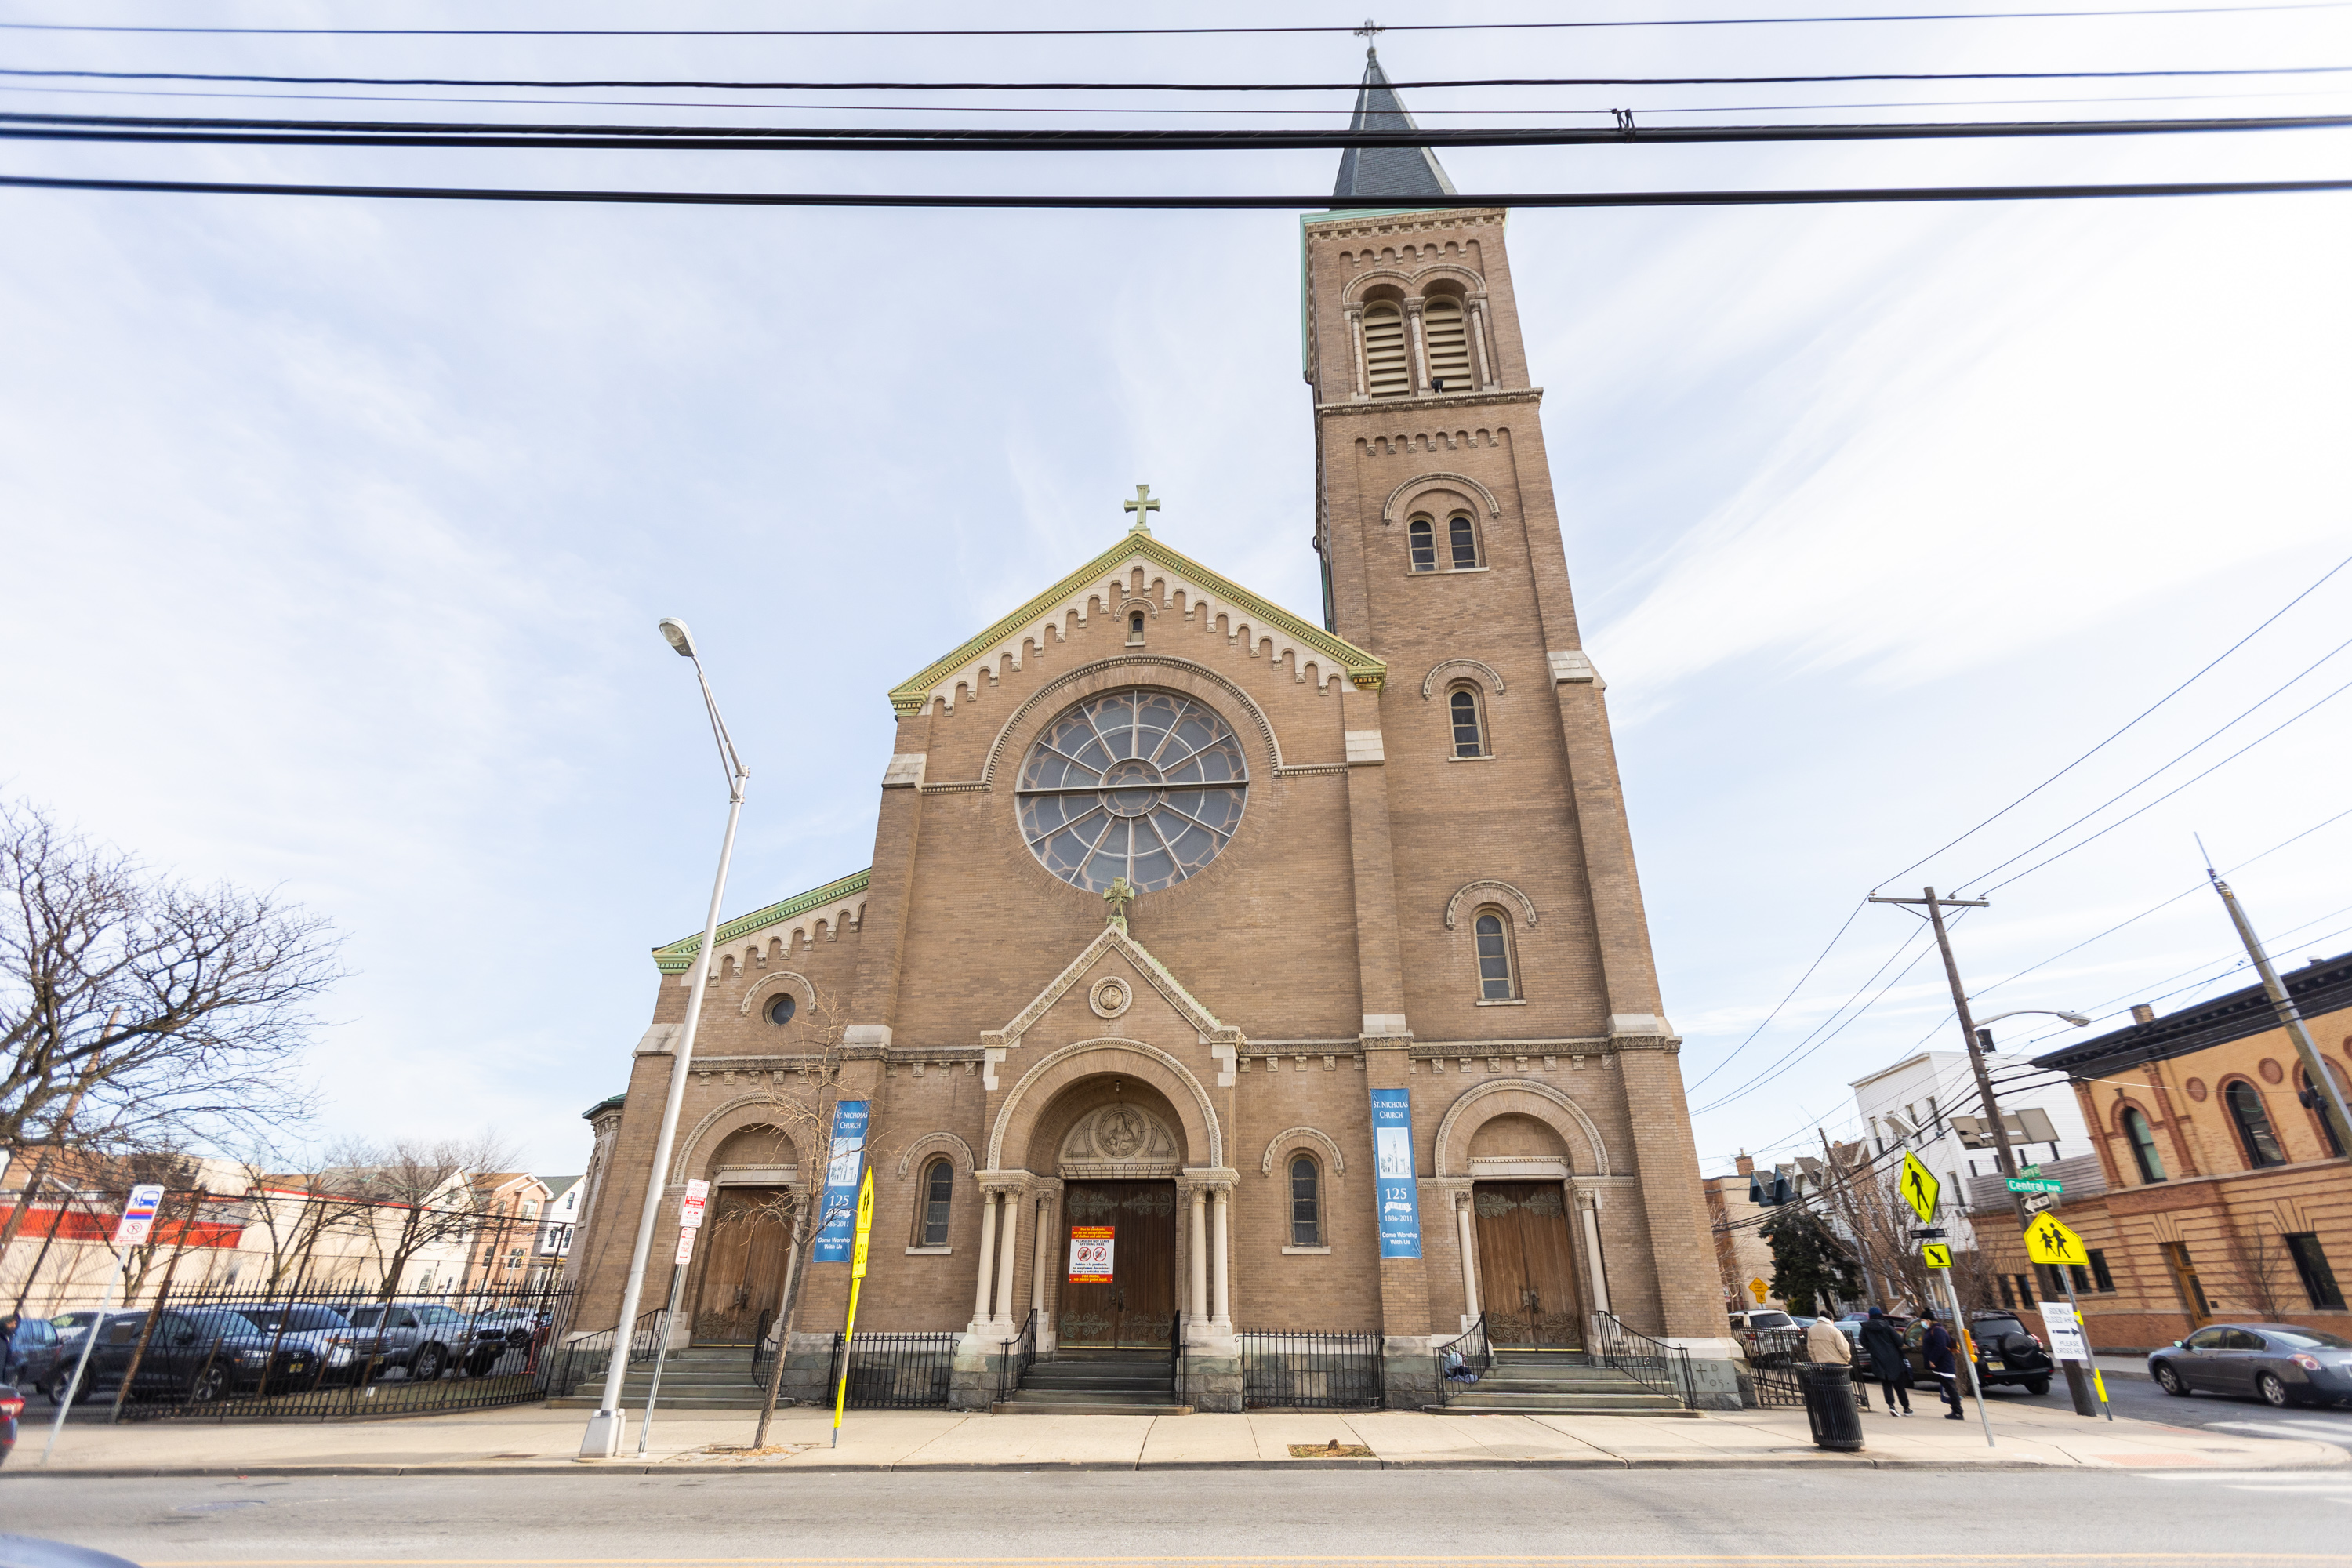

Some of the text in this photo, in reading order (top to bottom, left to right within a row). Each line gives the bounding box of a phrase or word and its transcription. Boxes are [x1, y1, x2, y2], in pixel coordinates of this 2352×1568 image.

[2008, 1180, 2045, 1191] Central
[1385, 1188, 1407, 1199] 125
[829, 1195, 849, 1206] 125
